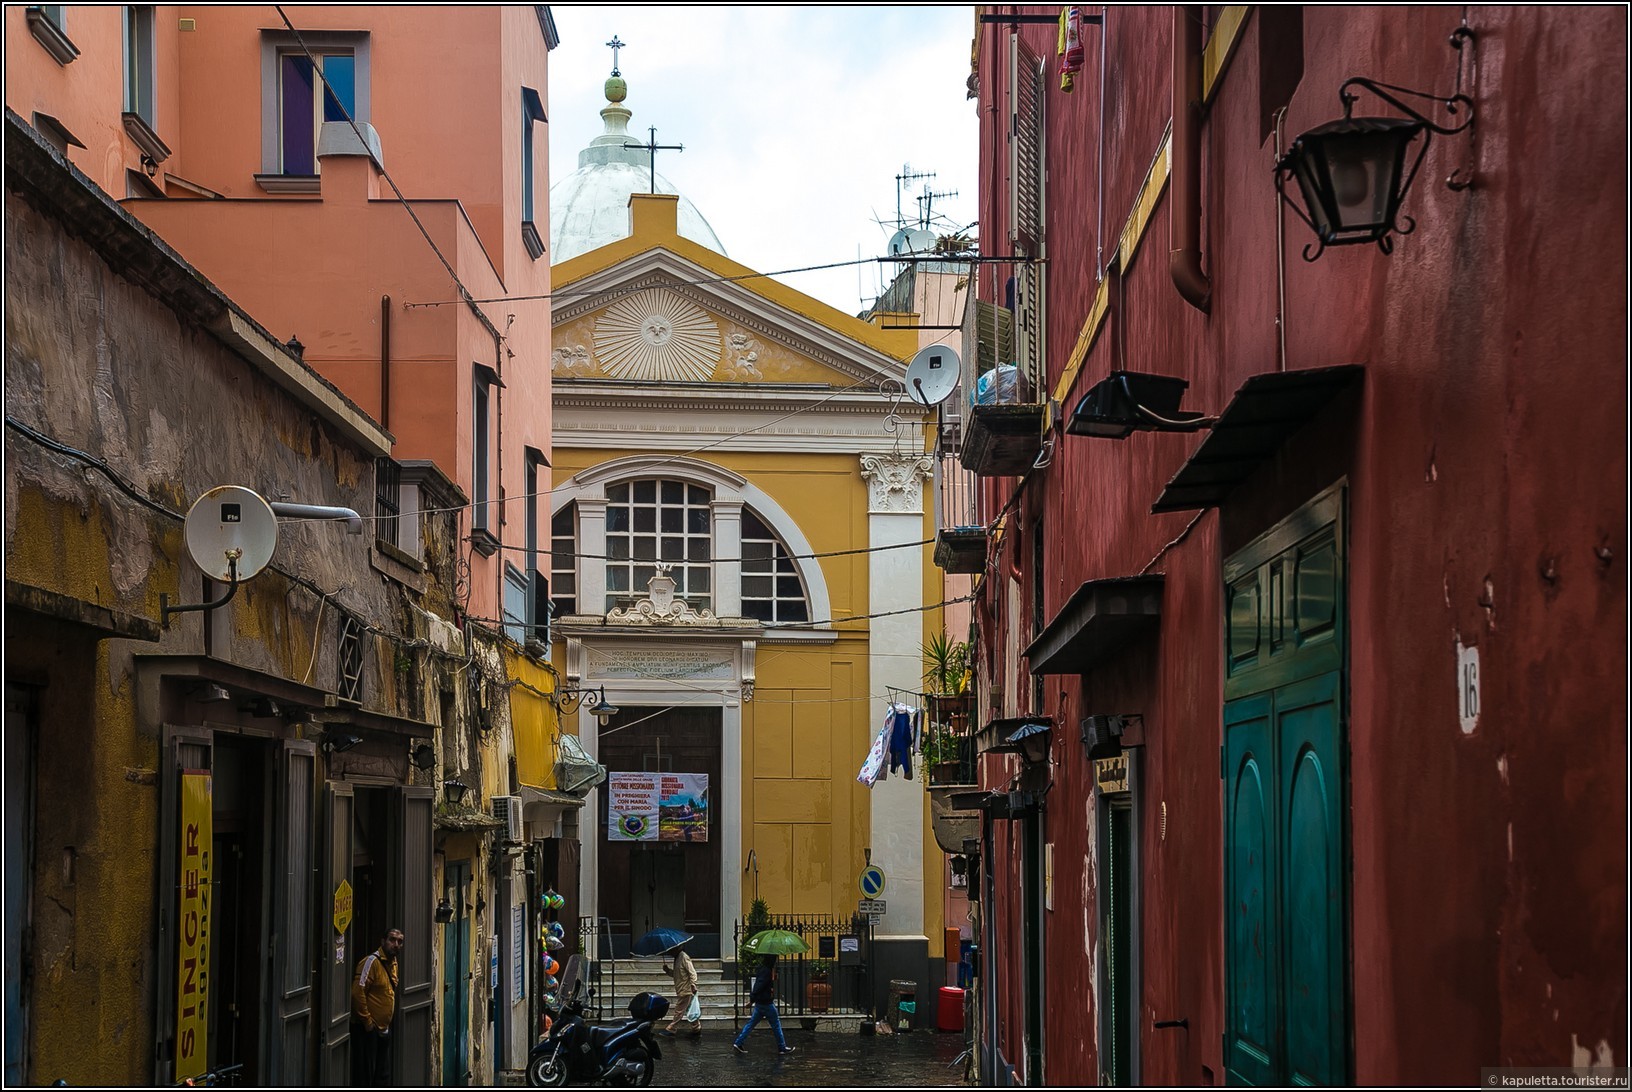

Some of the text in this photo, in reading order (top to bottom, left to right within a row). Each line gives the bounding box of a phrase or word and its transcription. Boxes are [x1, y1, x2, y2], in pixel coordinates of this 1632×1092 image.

[1464, 662, 1477, 718] 16
[334, 895, 352, 914] SINGER
[181, 822, 198, 1059] SINGER
